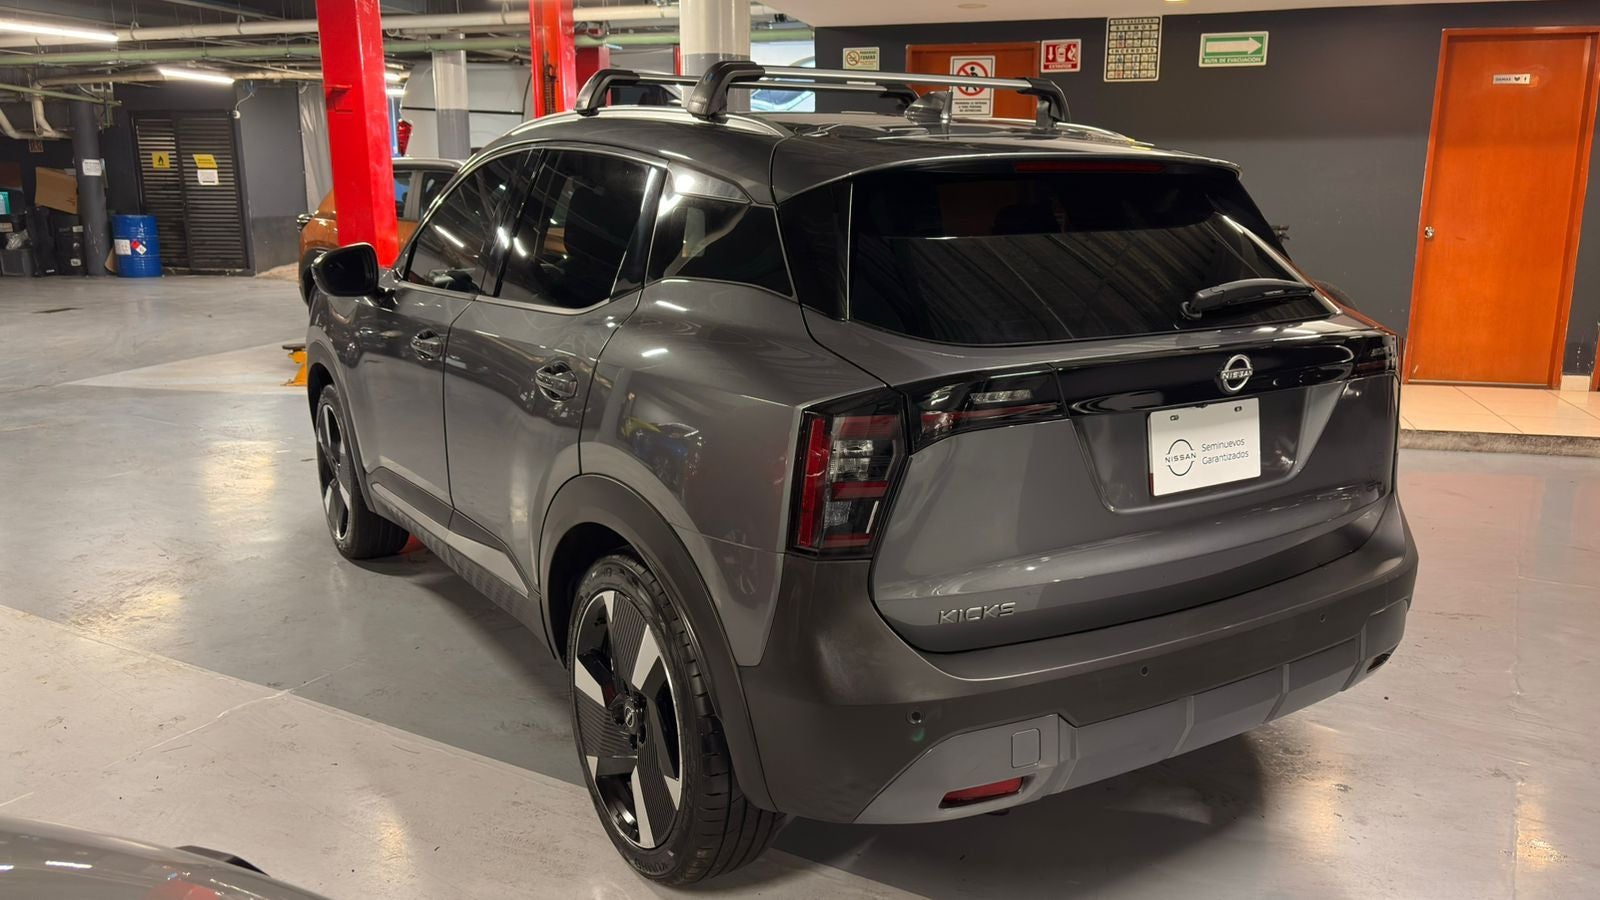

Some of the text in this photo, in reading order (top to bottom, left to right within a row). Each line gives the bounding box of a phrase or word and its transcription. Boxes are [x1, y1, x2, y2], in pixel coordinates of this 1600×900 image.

[1221, 369, 1252, 380] NISSAN
[1201, 438, 1245, 452] Seminuevos
[1165, 452, 1197, 463] NISSAN
[1201, 450, 1249, 465] Garantizados
[938, 601, 1016, 624] KICKS
